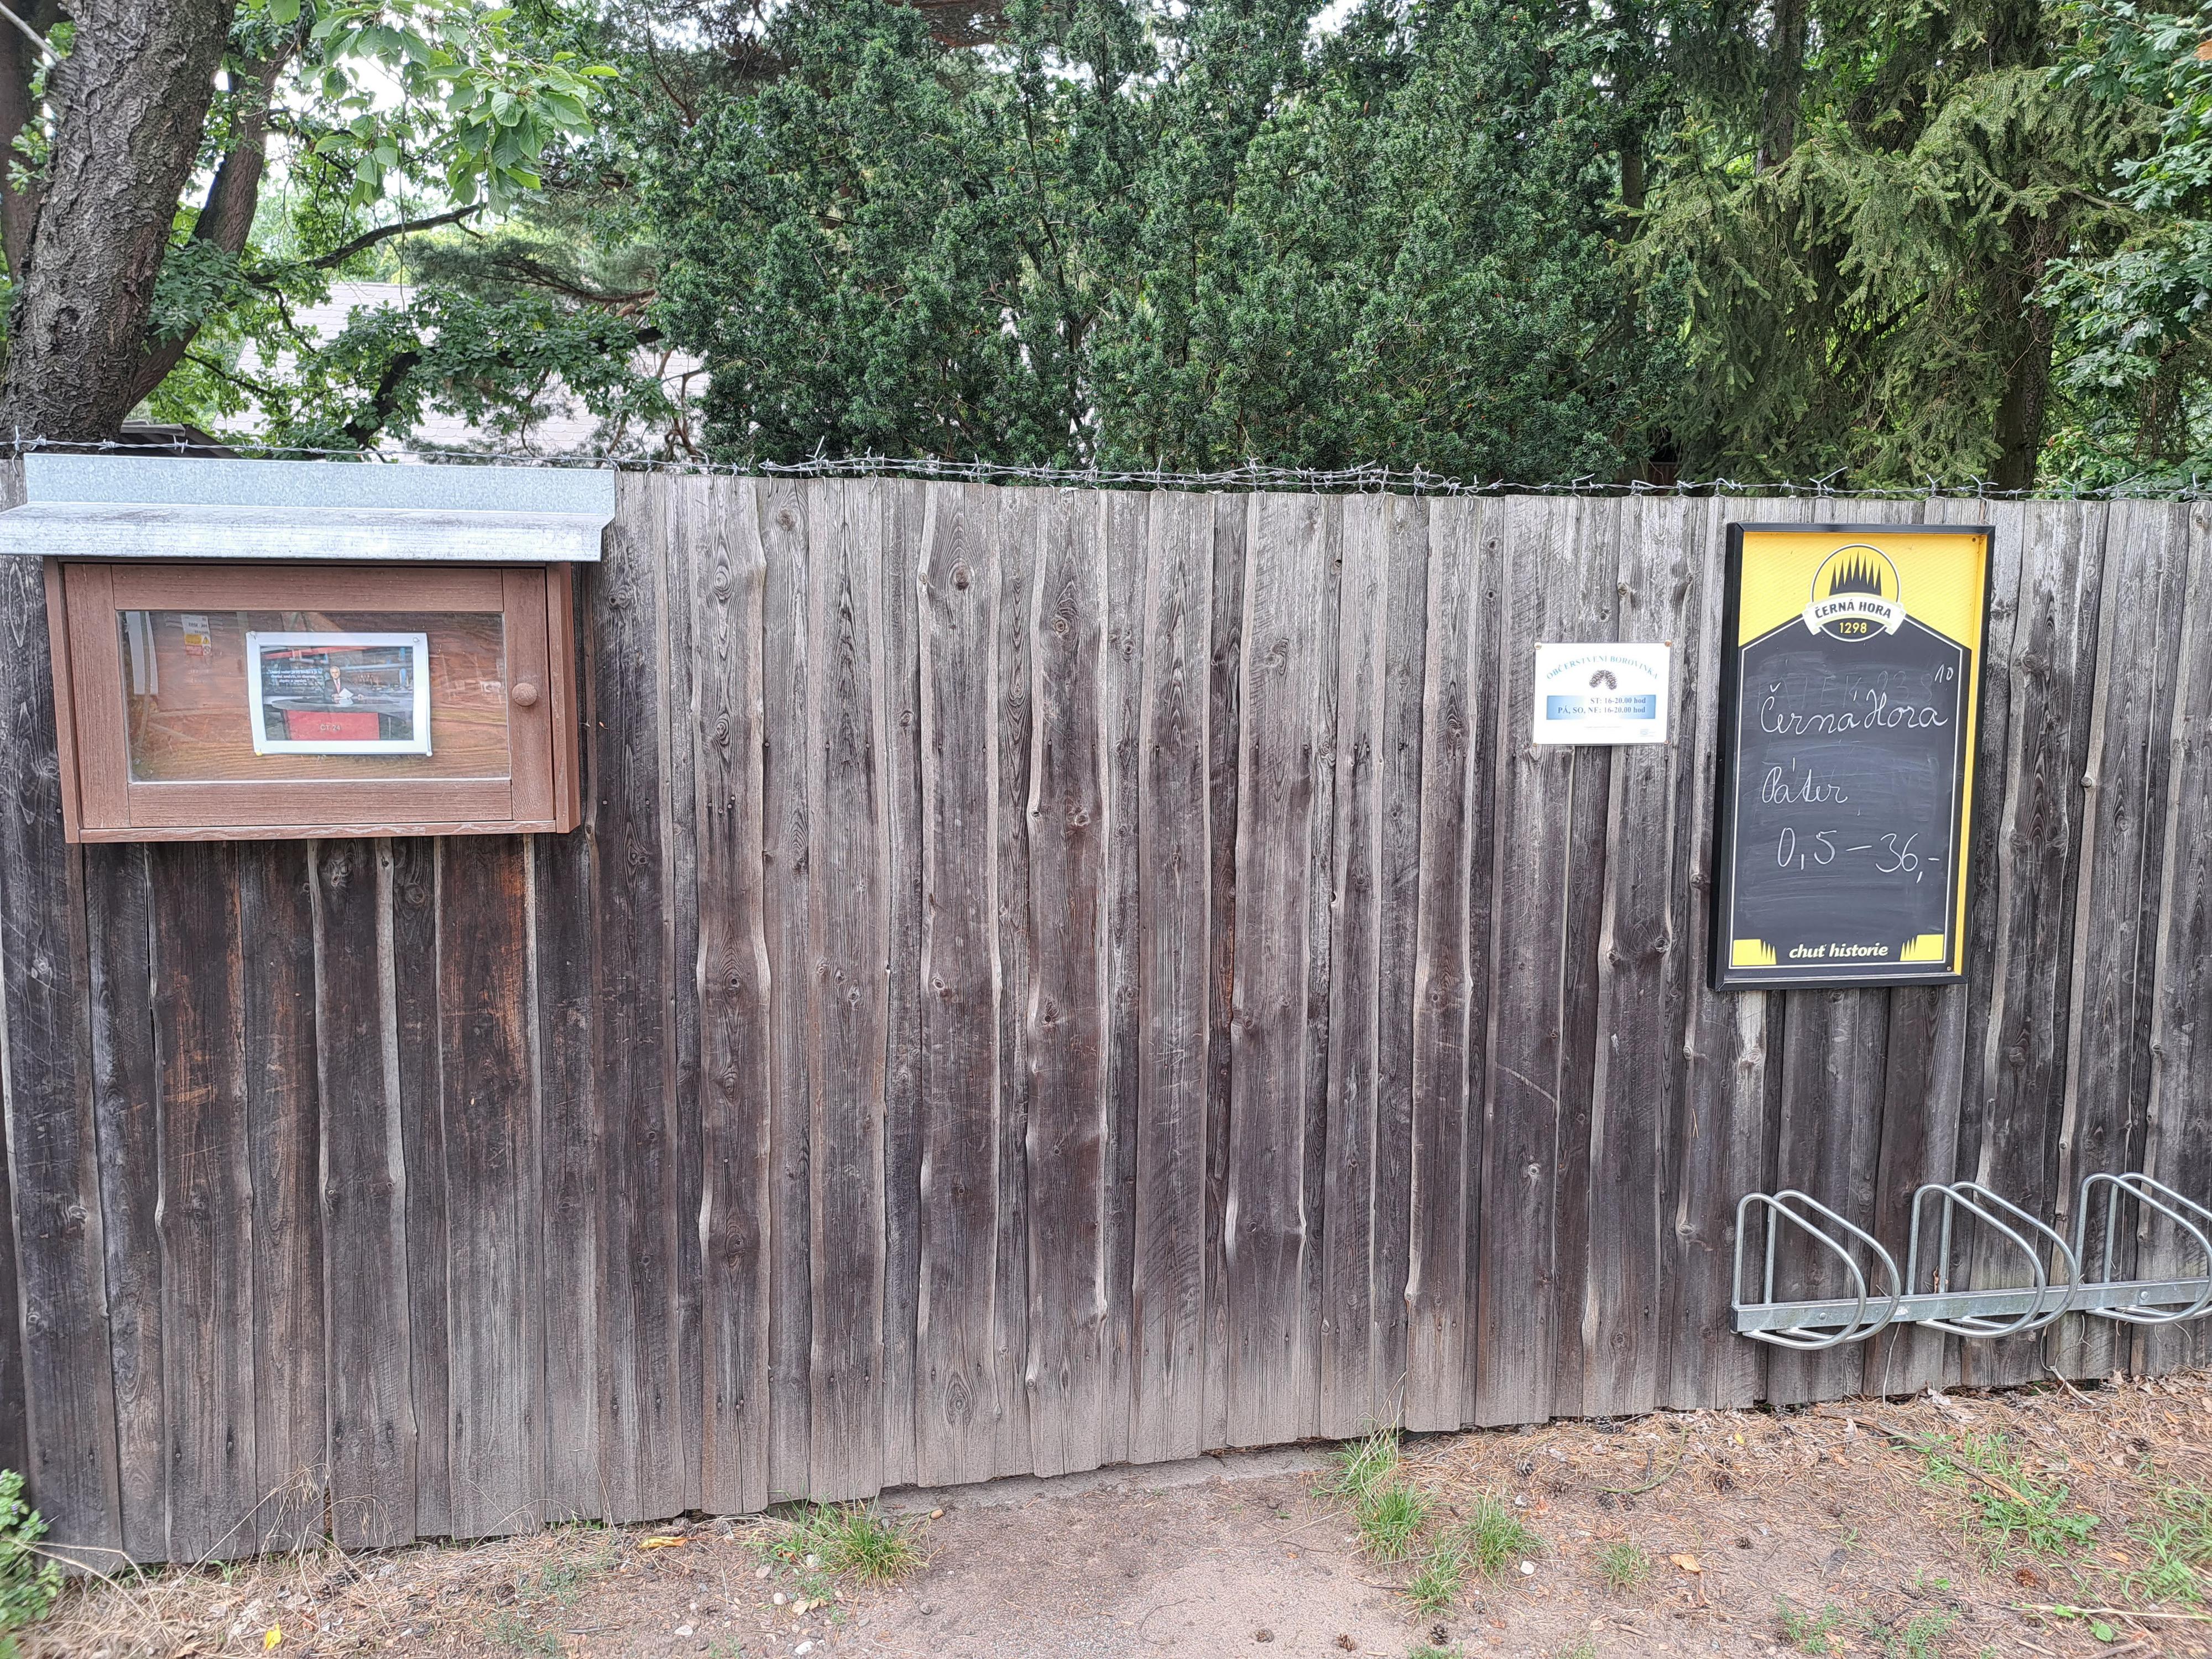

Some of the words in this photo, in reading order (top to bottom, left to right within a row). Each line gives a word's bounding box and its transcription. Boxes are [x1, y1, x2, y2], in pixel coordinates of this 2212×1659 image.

[1814, 598, 1855, 620] ČERNÁ
[1859, 600, 1892, 619] HORA
[1839, 622, 1867, 634] 1298
[1864, 685, 1949, 729] Hora
[1934, 664, 1954, 684] 10
[1558, 705, 1571, 714] PÁ,
[1788, 942, 1827, 959] chuť
[1828, 942, 1889, 958] historie
